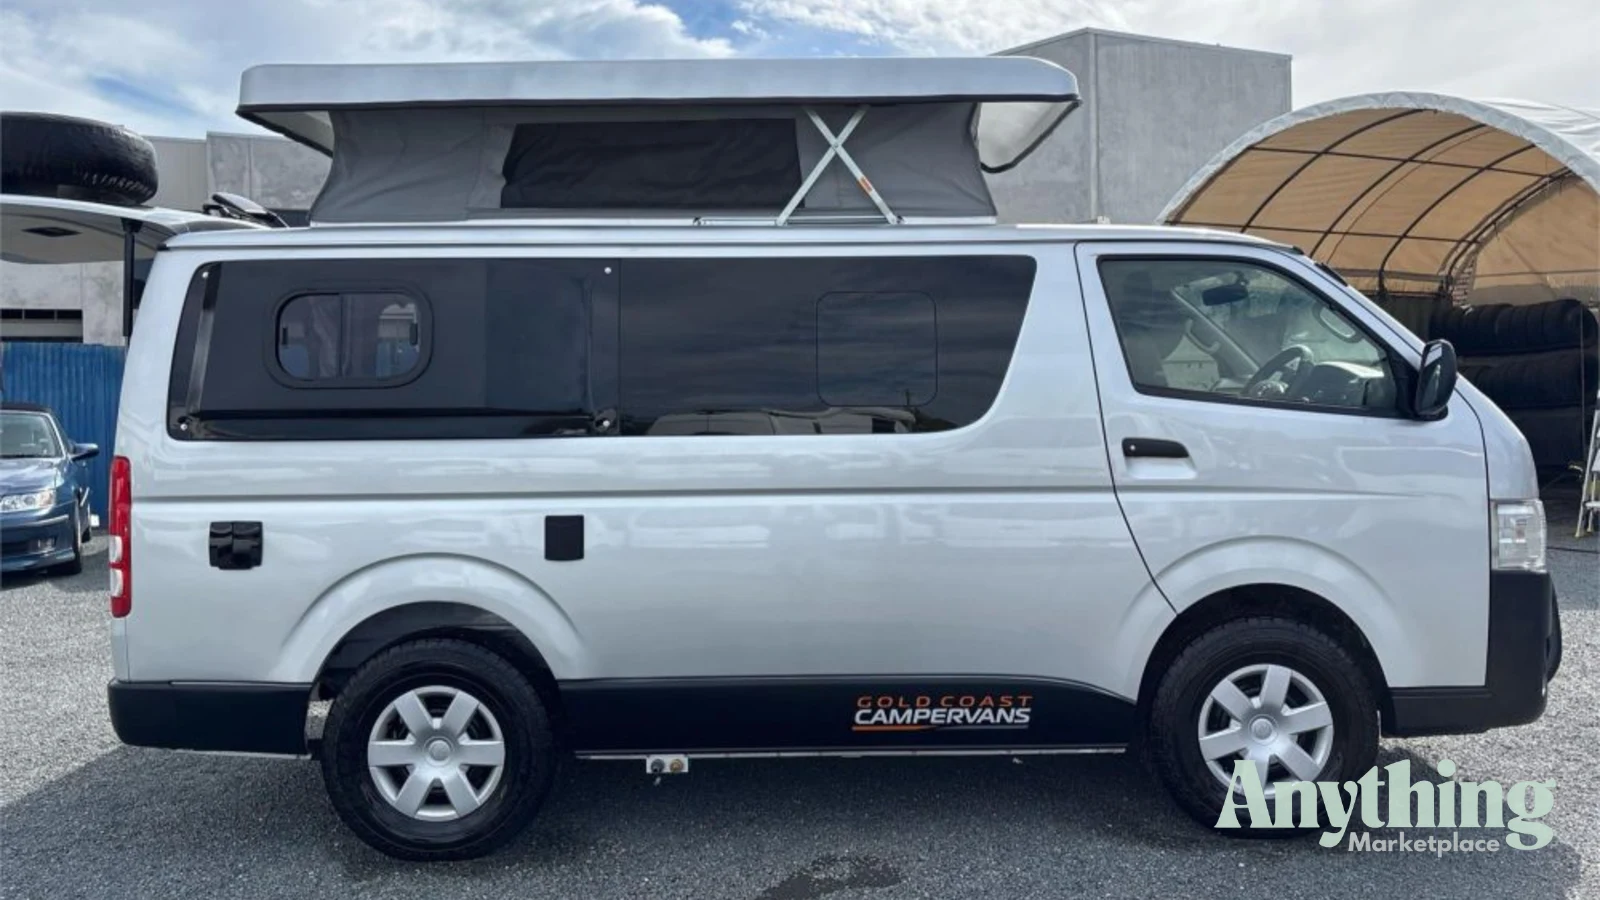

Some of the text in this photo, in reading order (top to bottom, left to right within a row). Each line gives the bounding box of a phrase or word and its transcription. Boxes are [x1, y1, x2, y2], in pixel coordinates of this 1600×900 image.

[857, 695, 1032, 708] GOLD COAST
[854, 707, 1031, 724] CAMPERVANS
